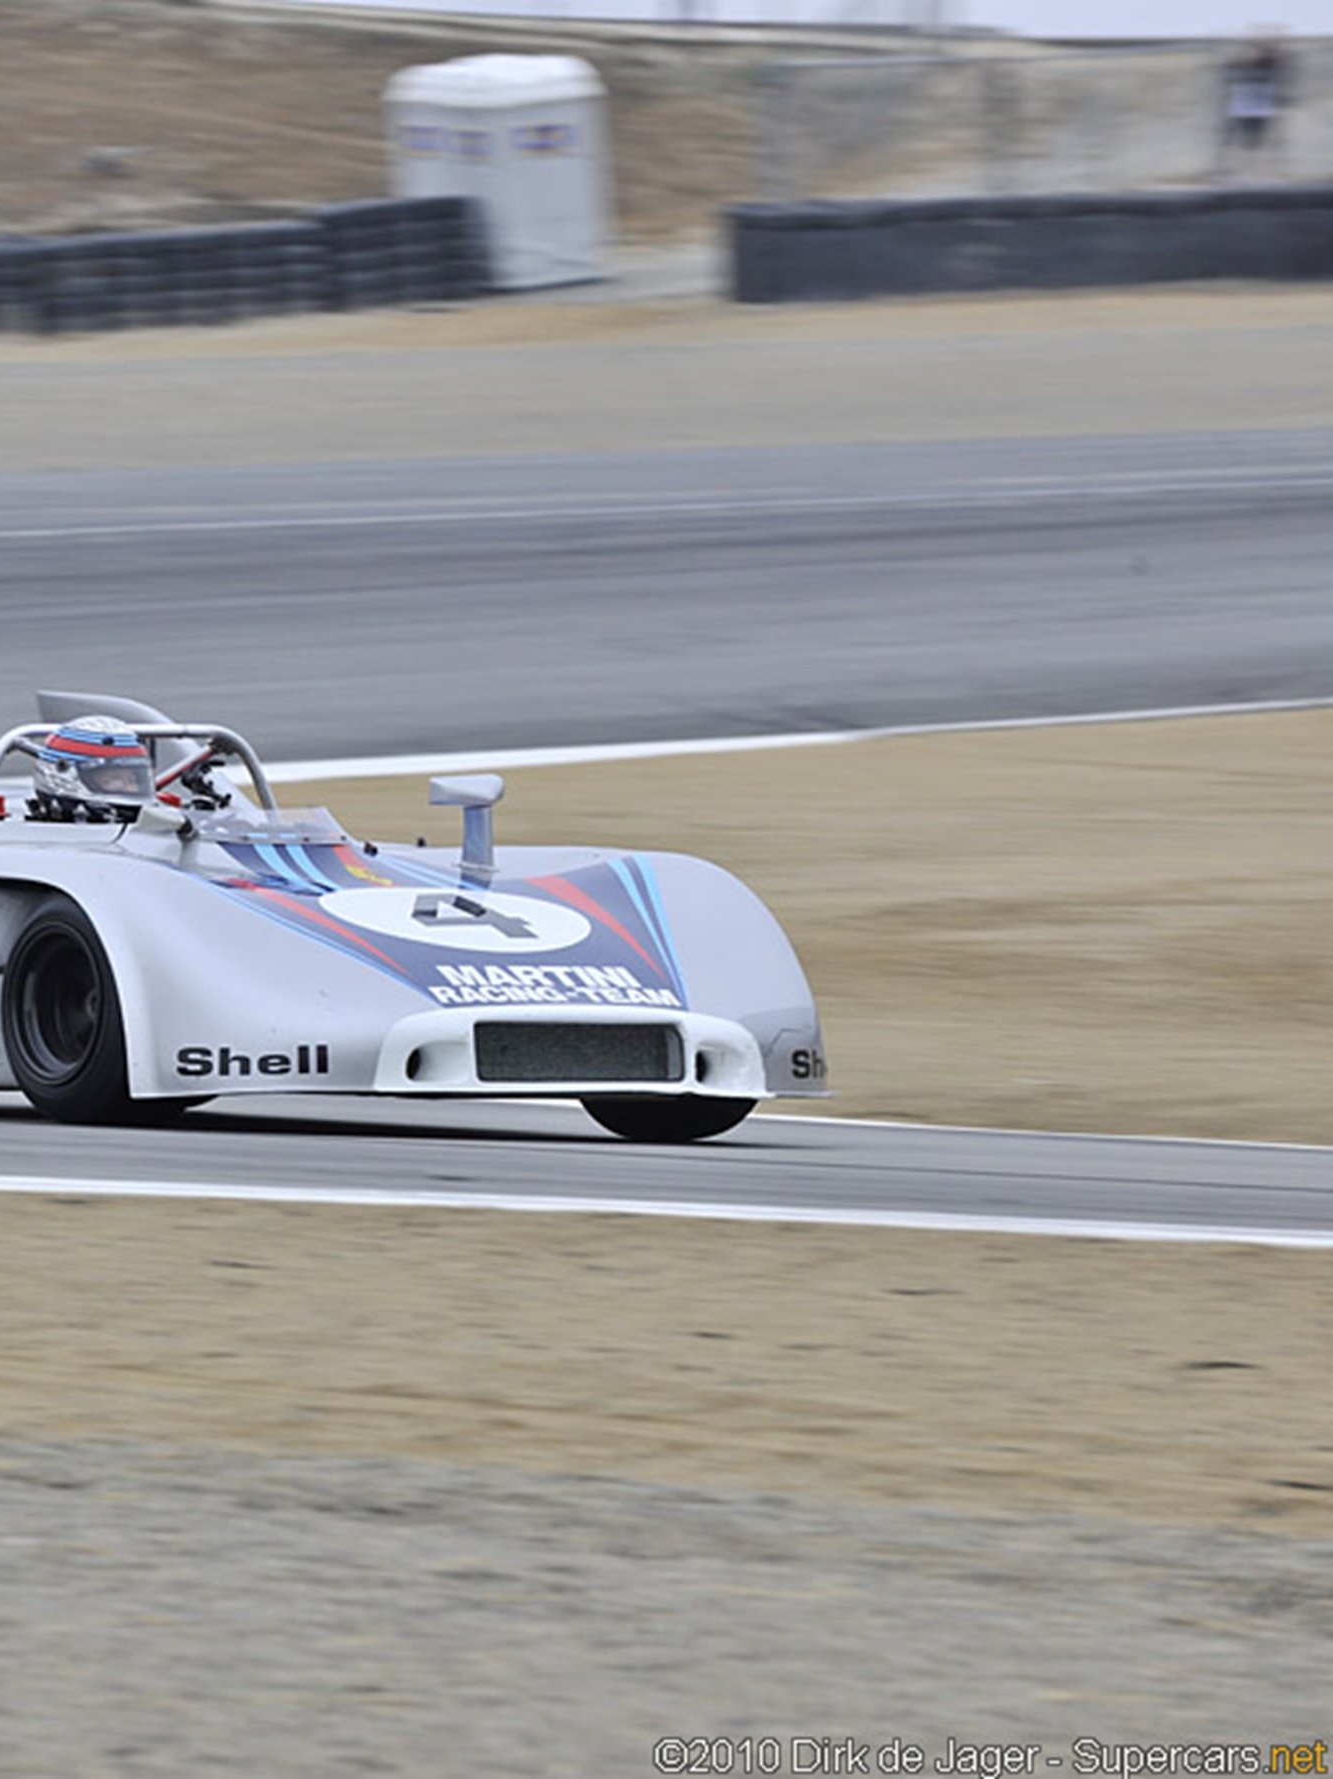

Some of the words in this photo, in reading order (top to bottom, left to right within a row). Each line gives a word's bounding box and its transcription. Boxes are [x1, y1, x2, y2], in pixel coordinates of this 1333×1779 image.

[411, 893, 538, 938] 4
[436, 965, 642, 988] MARTINI
[428, 986, 683, 1007] RACING-TEAM
[176, 1044, 330, 1077] Shell
[791, 1049, 828, 1079] Sh
